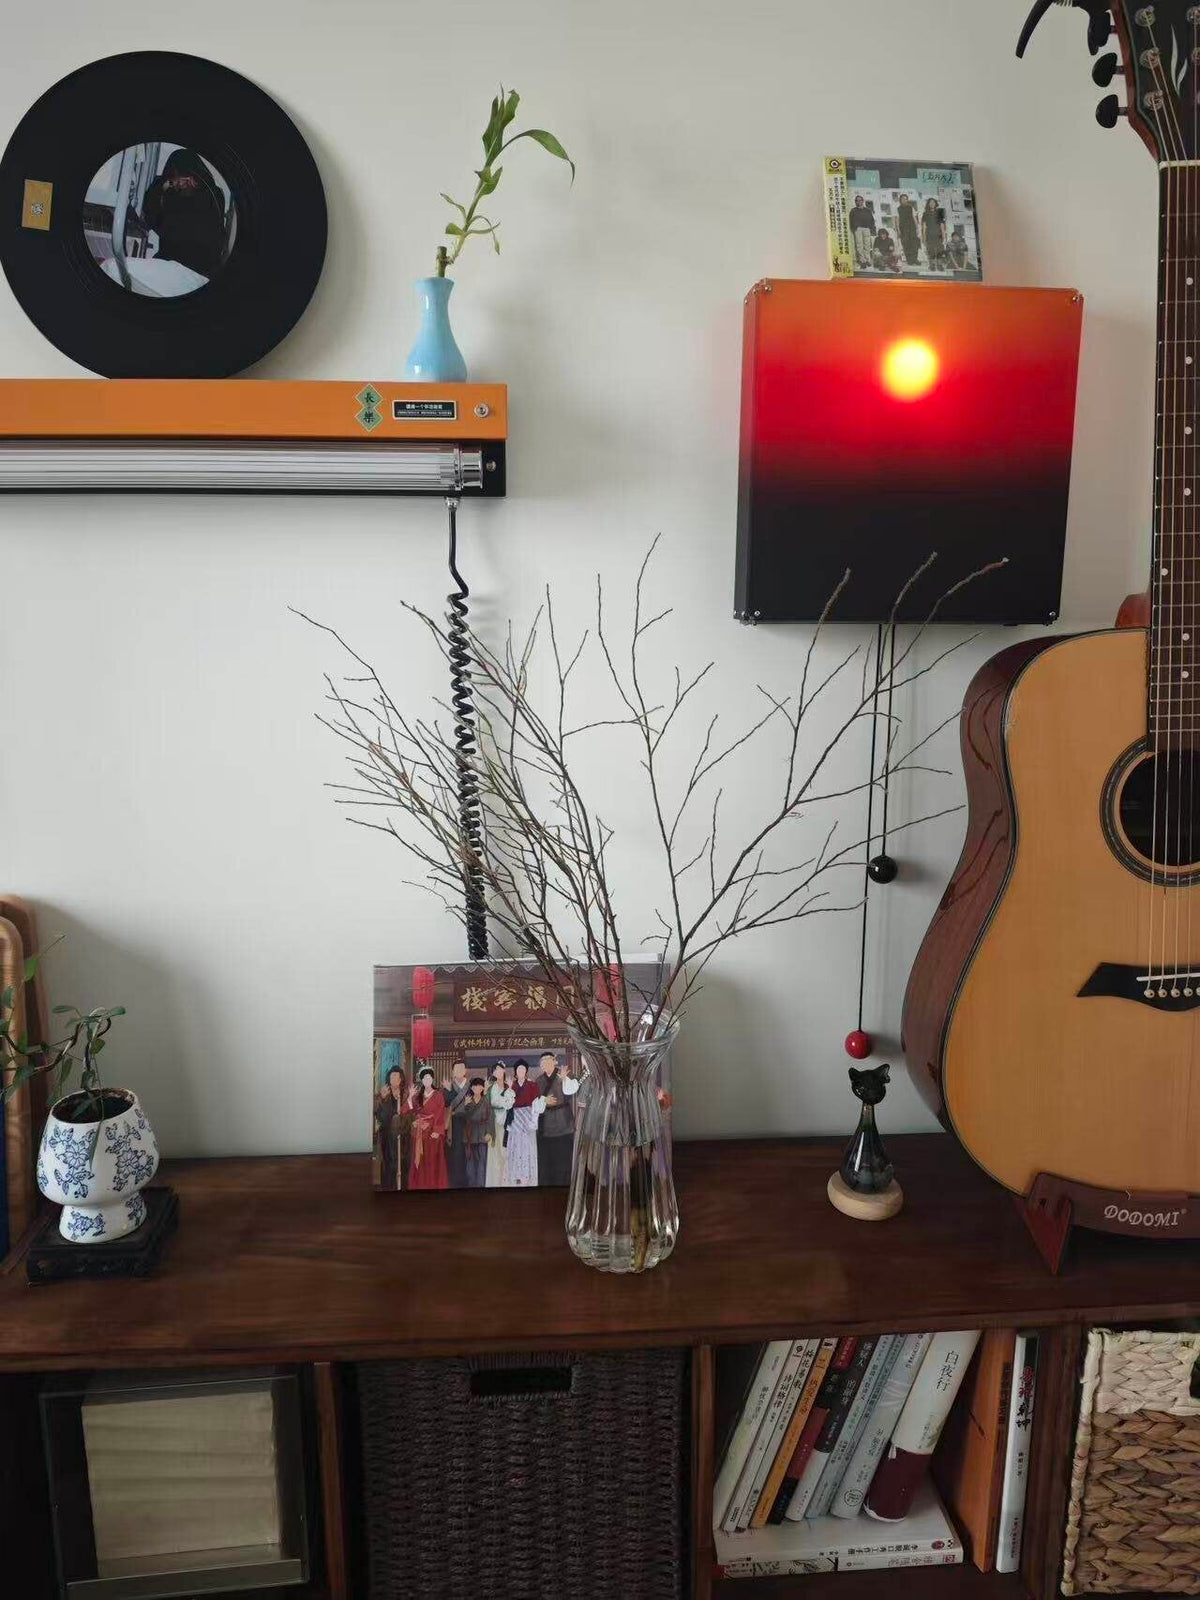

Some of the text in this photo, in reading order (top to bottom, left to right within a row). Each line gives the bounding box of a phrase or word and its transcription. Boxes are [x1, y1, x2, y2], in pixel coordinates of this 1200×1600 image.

[1104, 1204, 1179, 1227] DODOMI
[936, 1350, 959, 1392] 白夜行
